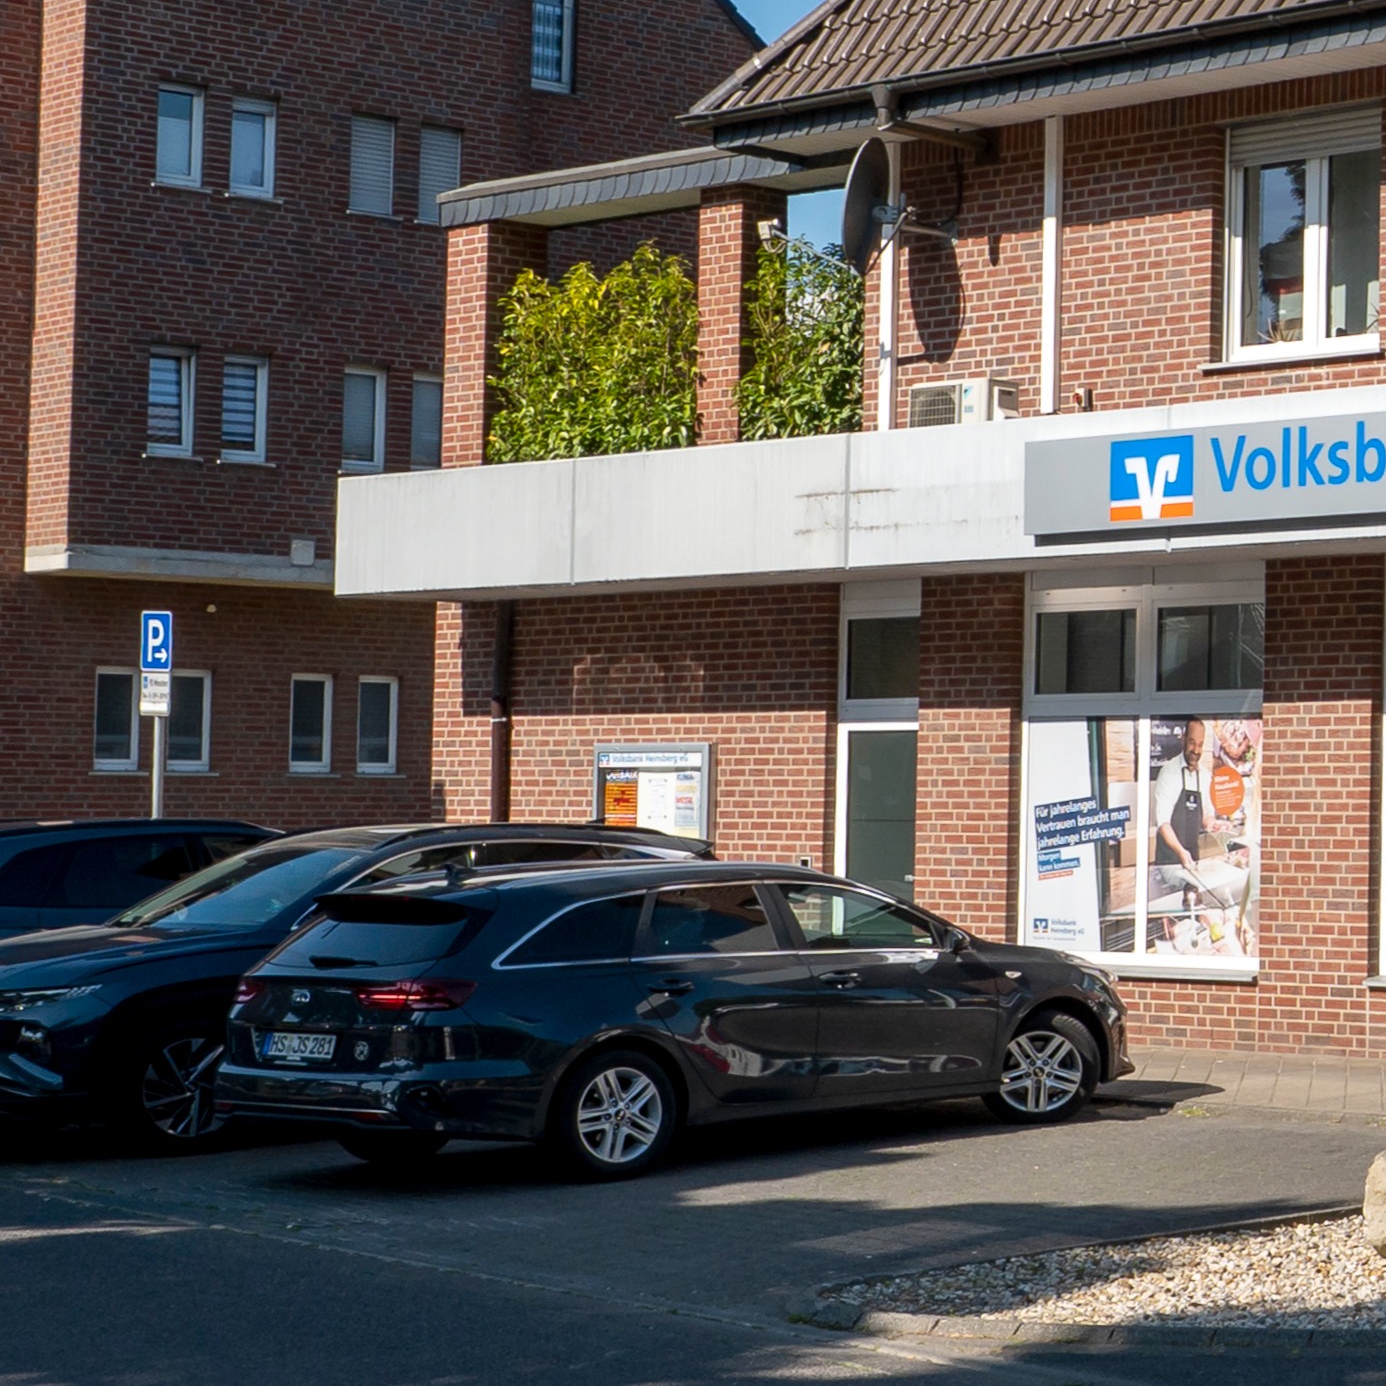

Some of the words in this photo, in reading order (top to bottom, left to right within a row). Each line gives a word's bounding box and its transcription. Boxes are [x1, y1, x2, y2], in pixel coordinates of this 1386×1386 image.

[147, 618, 165, 663] P
[612, 755, 643, 763] Volksbank
[645, 755, 677, 764] Heinsberg
[1035, 806, 1049, 818] Für
[1049, 800, 1097, 819] jahrelanges
[1036, 818, 1077, 833] Vertrauen
[1077, 810, 1110, 827] braucht
[1110, 810, 1130, 821] man
[1037, 833, 1080, 851] jahrelange
[1081, 826, 1125, 842] Erfahrung.
[270, 1033, 288, 1054] HS
[292, 1035, 310, 1055] JS
[309, 1036, 333, 1056] 281
